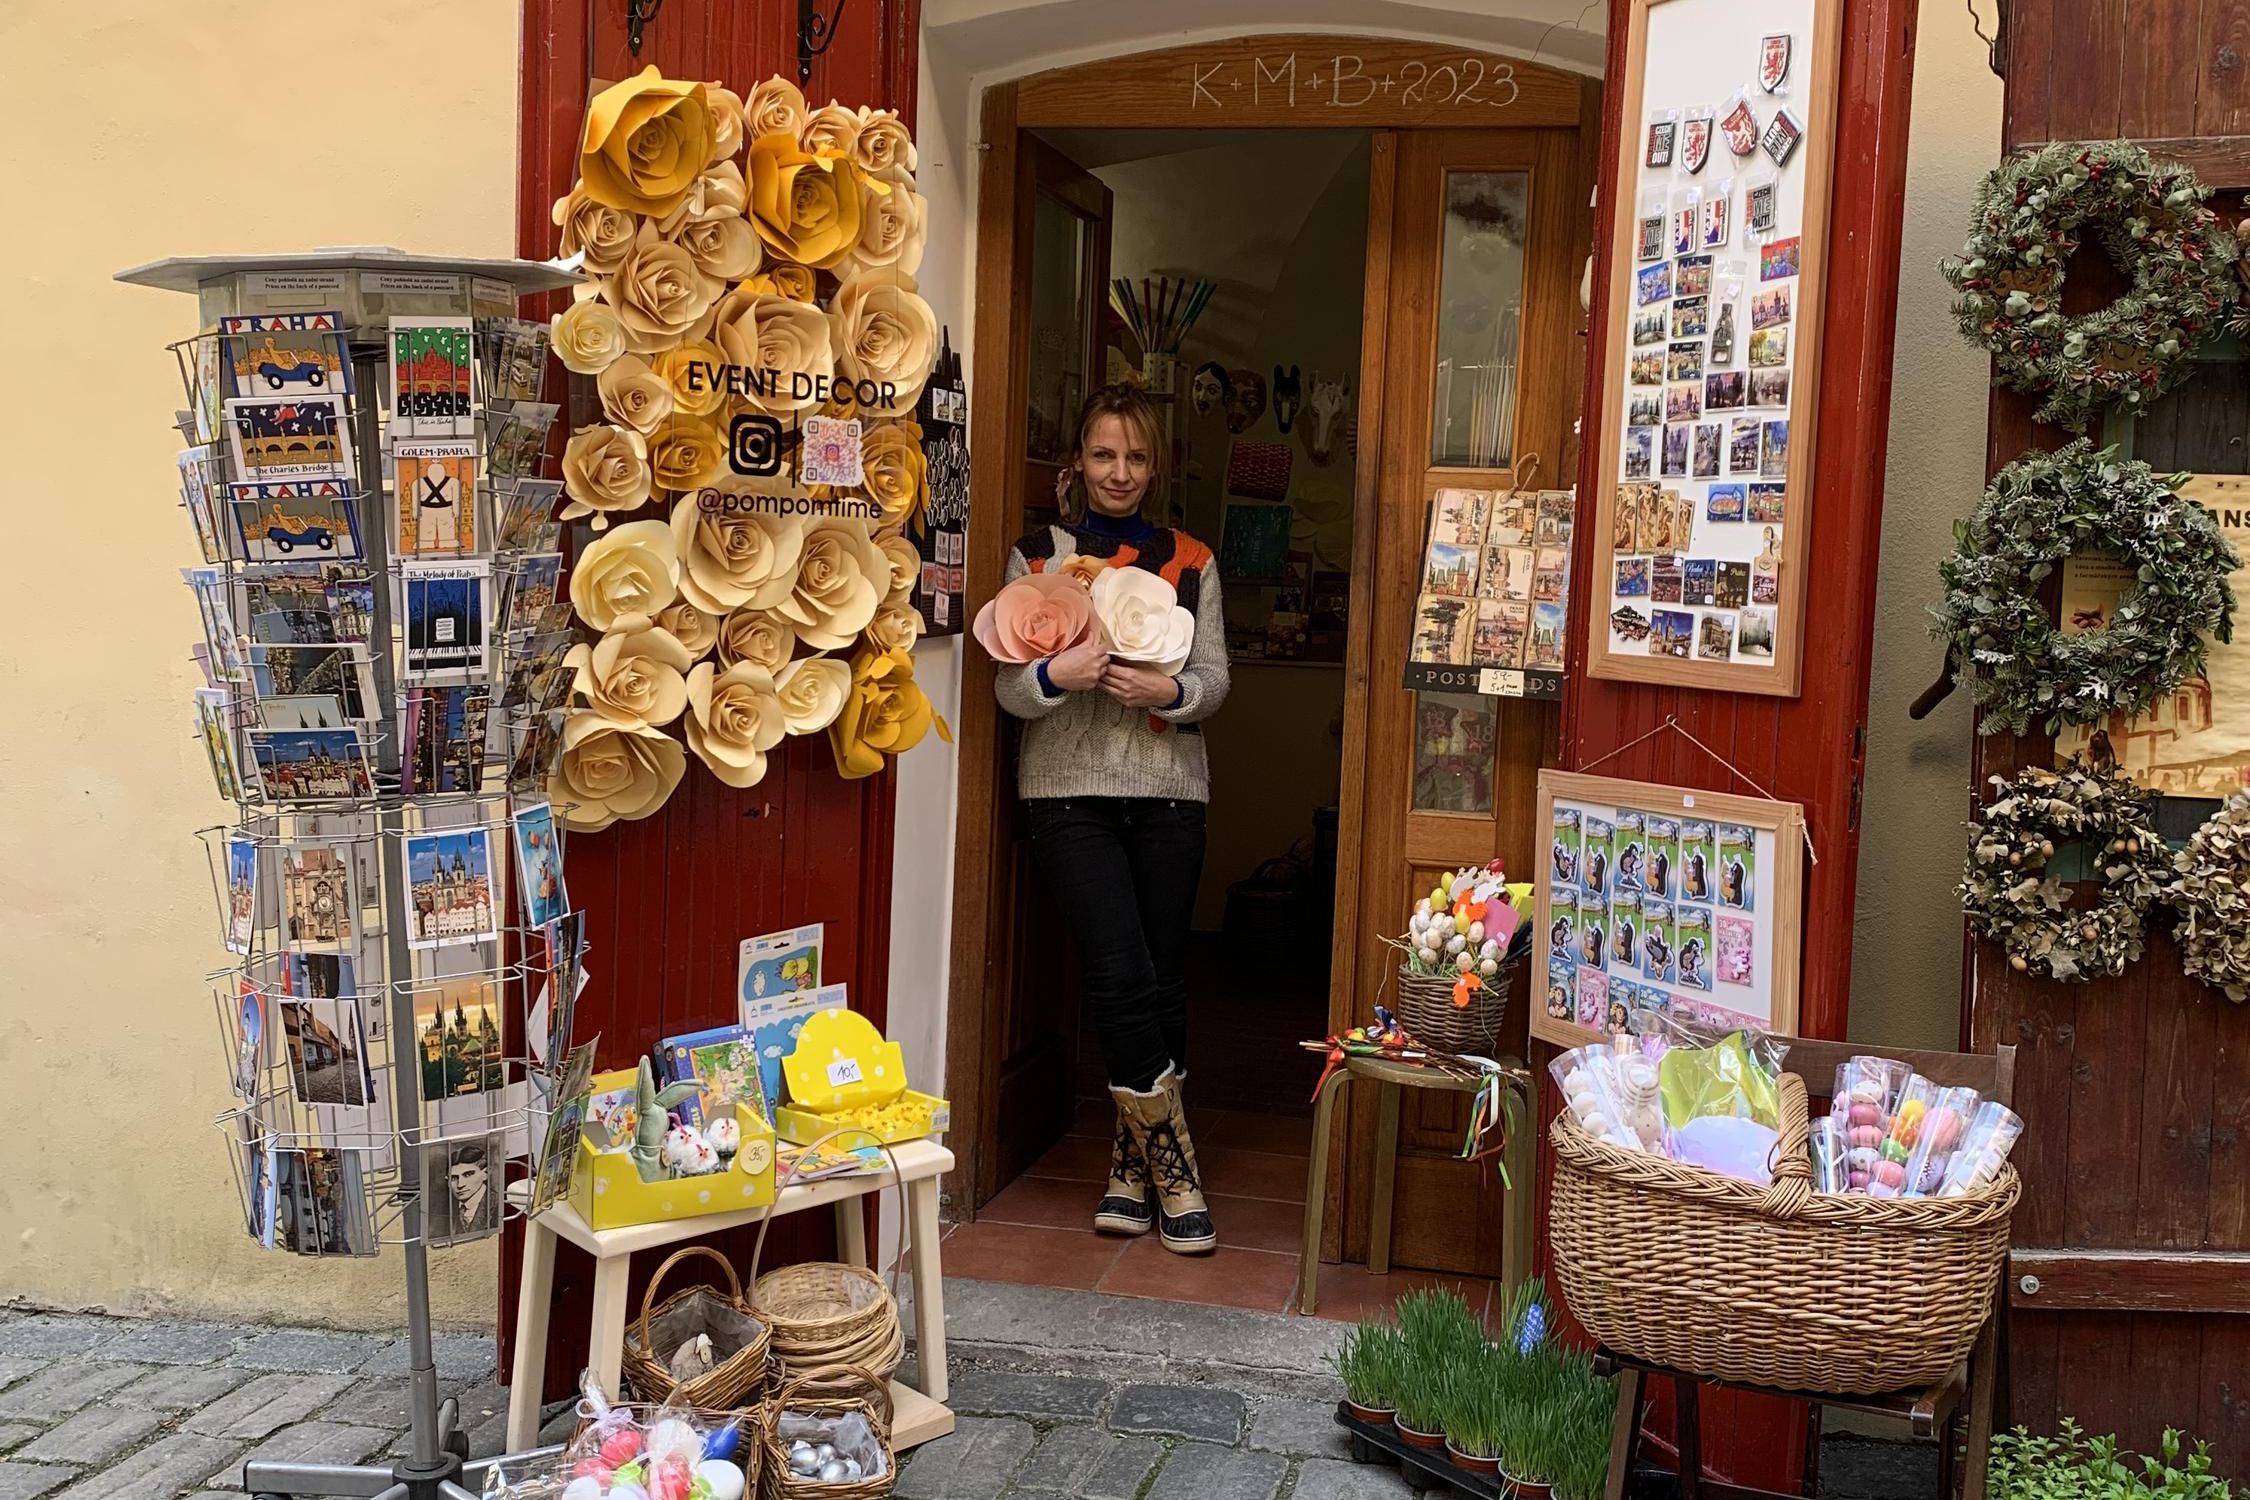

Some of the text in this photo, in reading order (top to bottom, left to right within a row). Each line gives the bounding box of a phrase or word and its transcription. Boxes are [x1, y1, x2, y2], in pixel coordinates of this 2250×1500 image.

[228, 313, 335, 335] PRAHA
[688, 360, 897, 410] EVENT DECOR
[237, 481, 341, 501] PRAHA
[696, 486, 883, 520] @pompomtime
[1424, 670, 1558, 693] POSTDS
